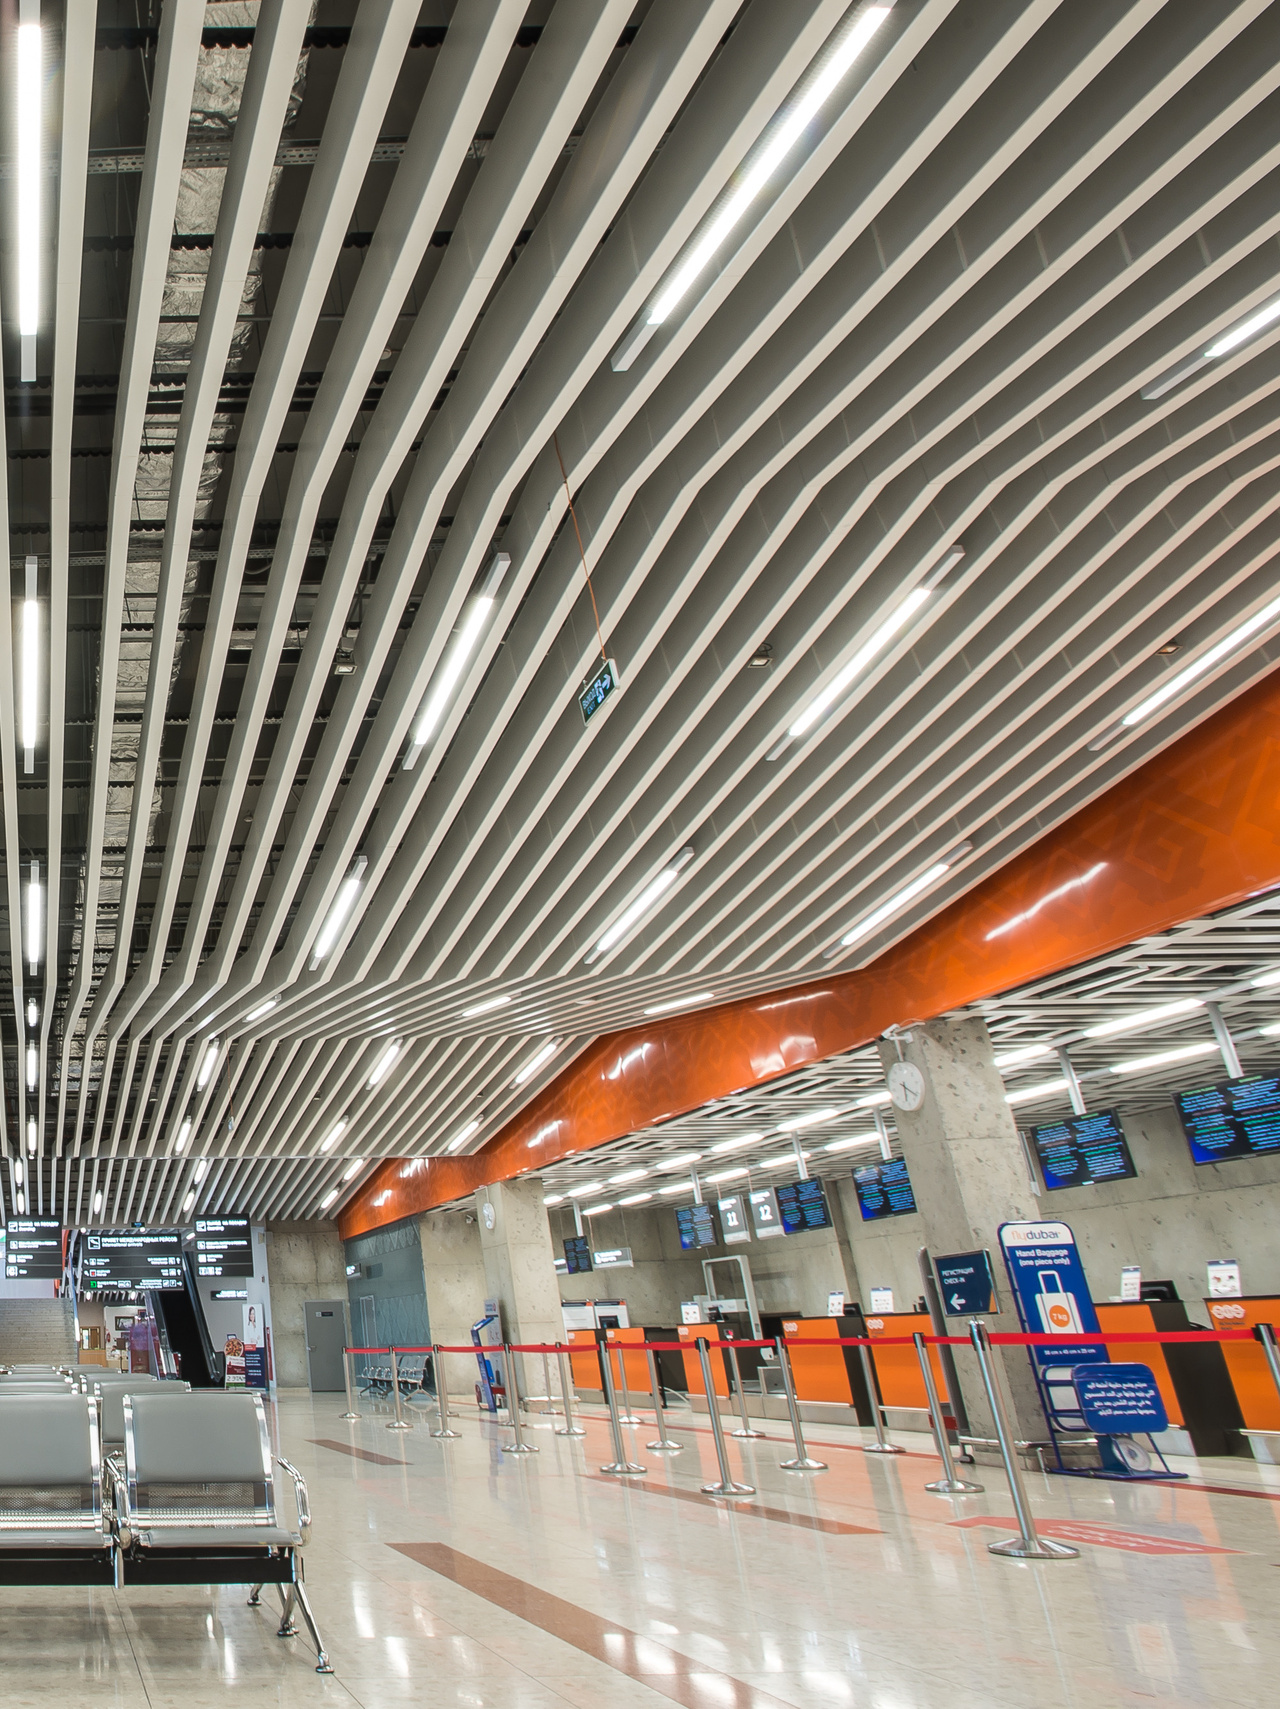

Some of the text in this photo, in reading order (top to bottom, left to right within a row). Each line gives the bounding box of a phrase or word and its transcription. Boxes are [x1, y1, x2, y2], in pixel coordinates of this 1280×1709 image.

[759, 1205, 773, 1221] 12
[727, 1212, 739, 1226] 11
[1012, 1230, 1060, 1240] flydubai
[1036, 1249, 1068, 1257] Baggage
[1019, 1257, 1071, 1267] (one piece only)
[942, 1267, 974, 1276] РЕГИСТРАЦИЯ
[944, 1277, 966, 1285] CHECK-IN
[1058, 1313, 1068, 1321] kg
